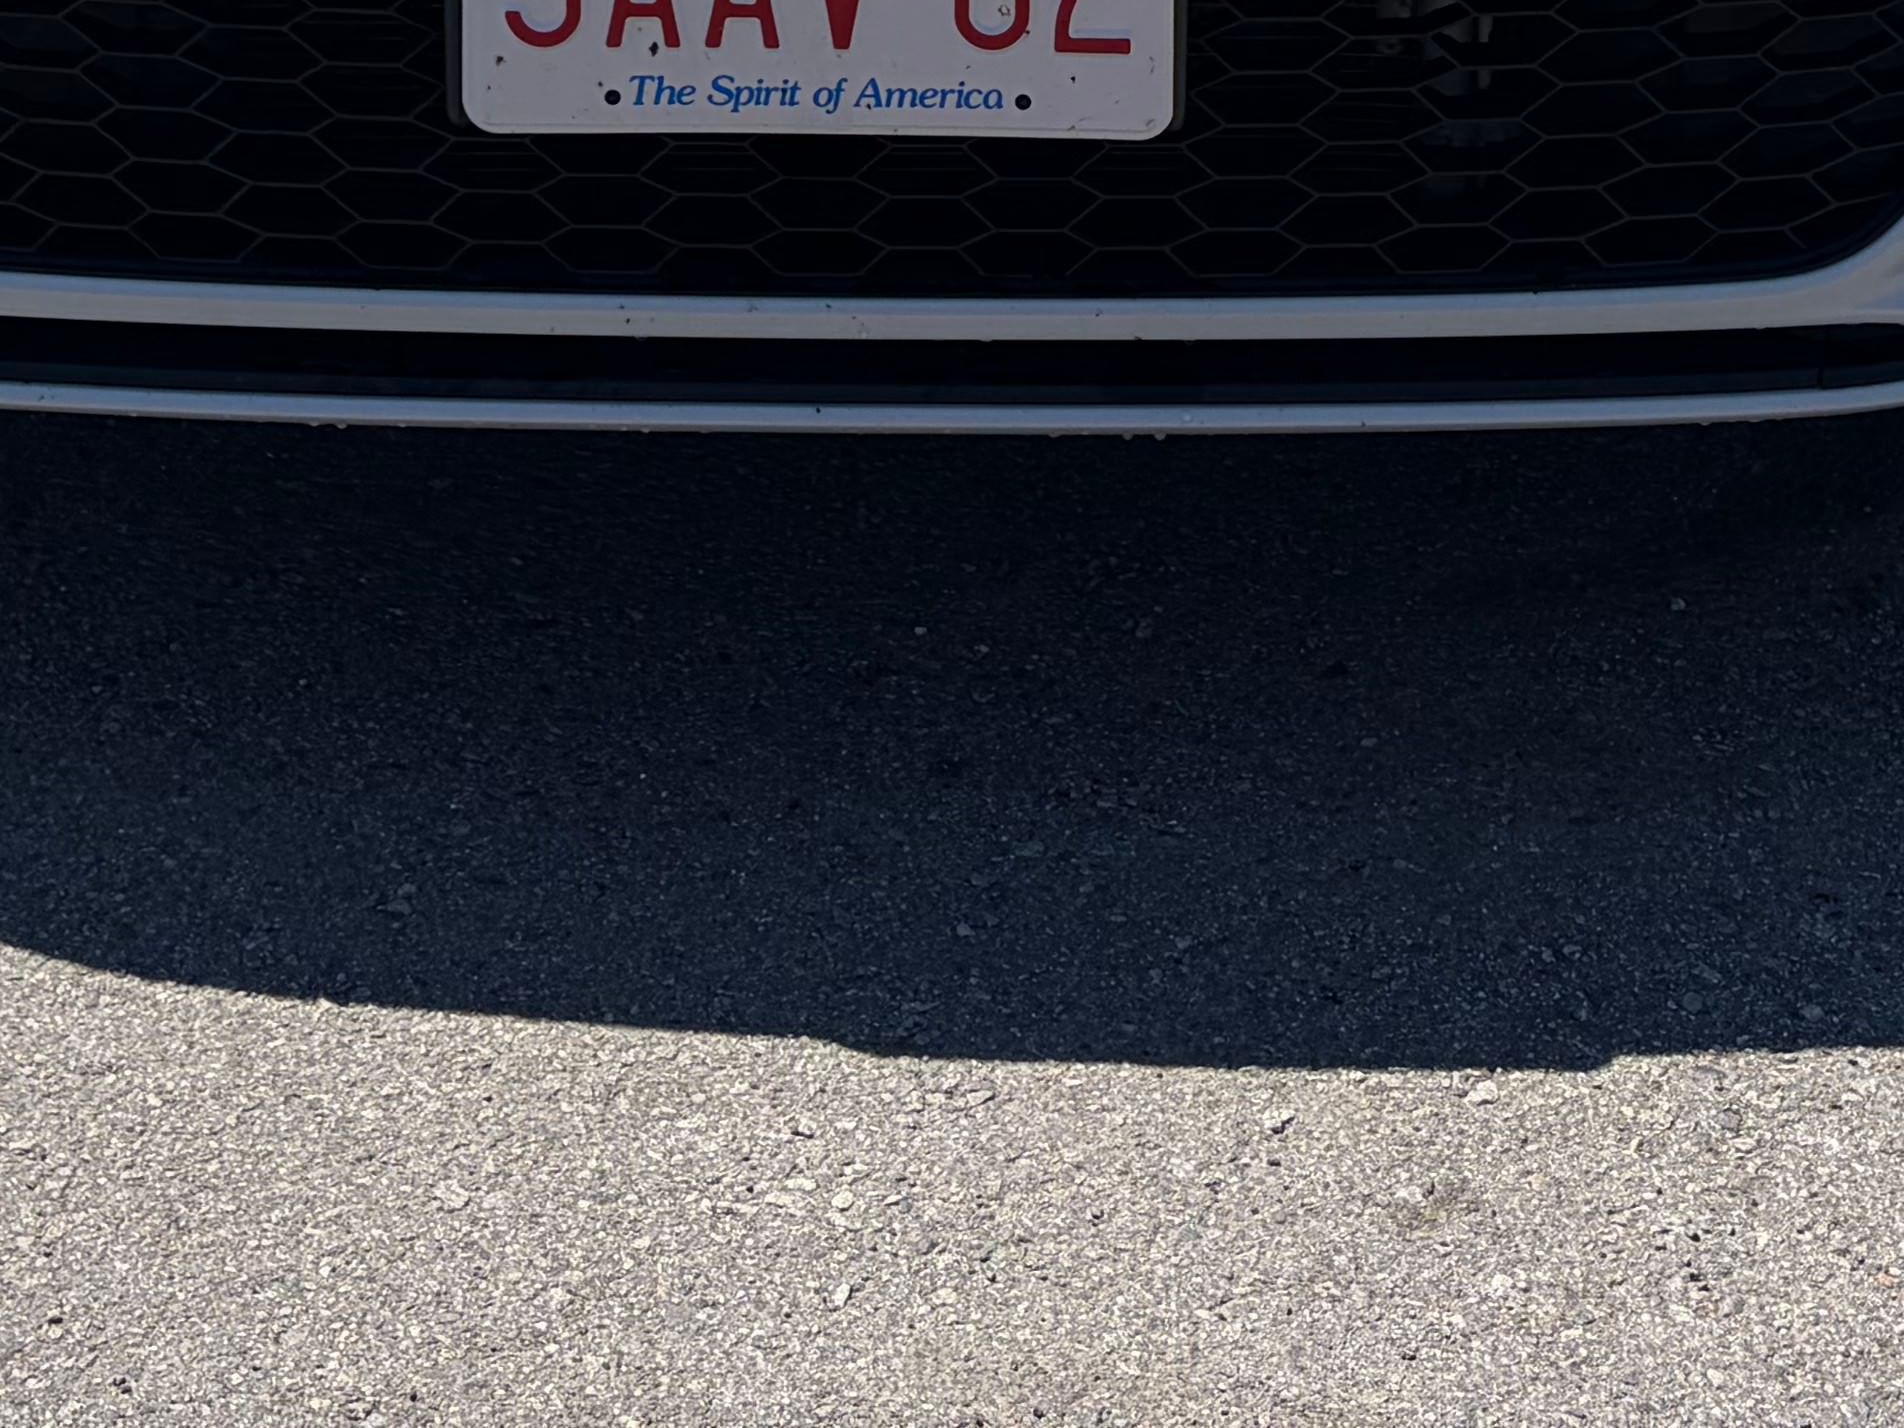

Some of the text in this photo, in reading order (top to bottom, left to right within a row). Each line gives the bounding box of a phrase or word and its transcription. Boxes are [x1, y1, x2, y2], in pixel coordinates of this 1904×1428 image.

[628, 74, 1005, 115] The Spirit of America
